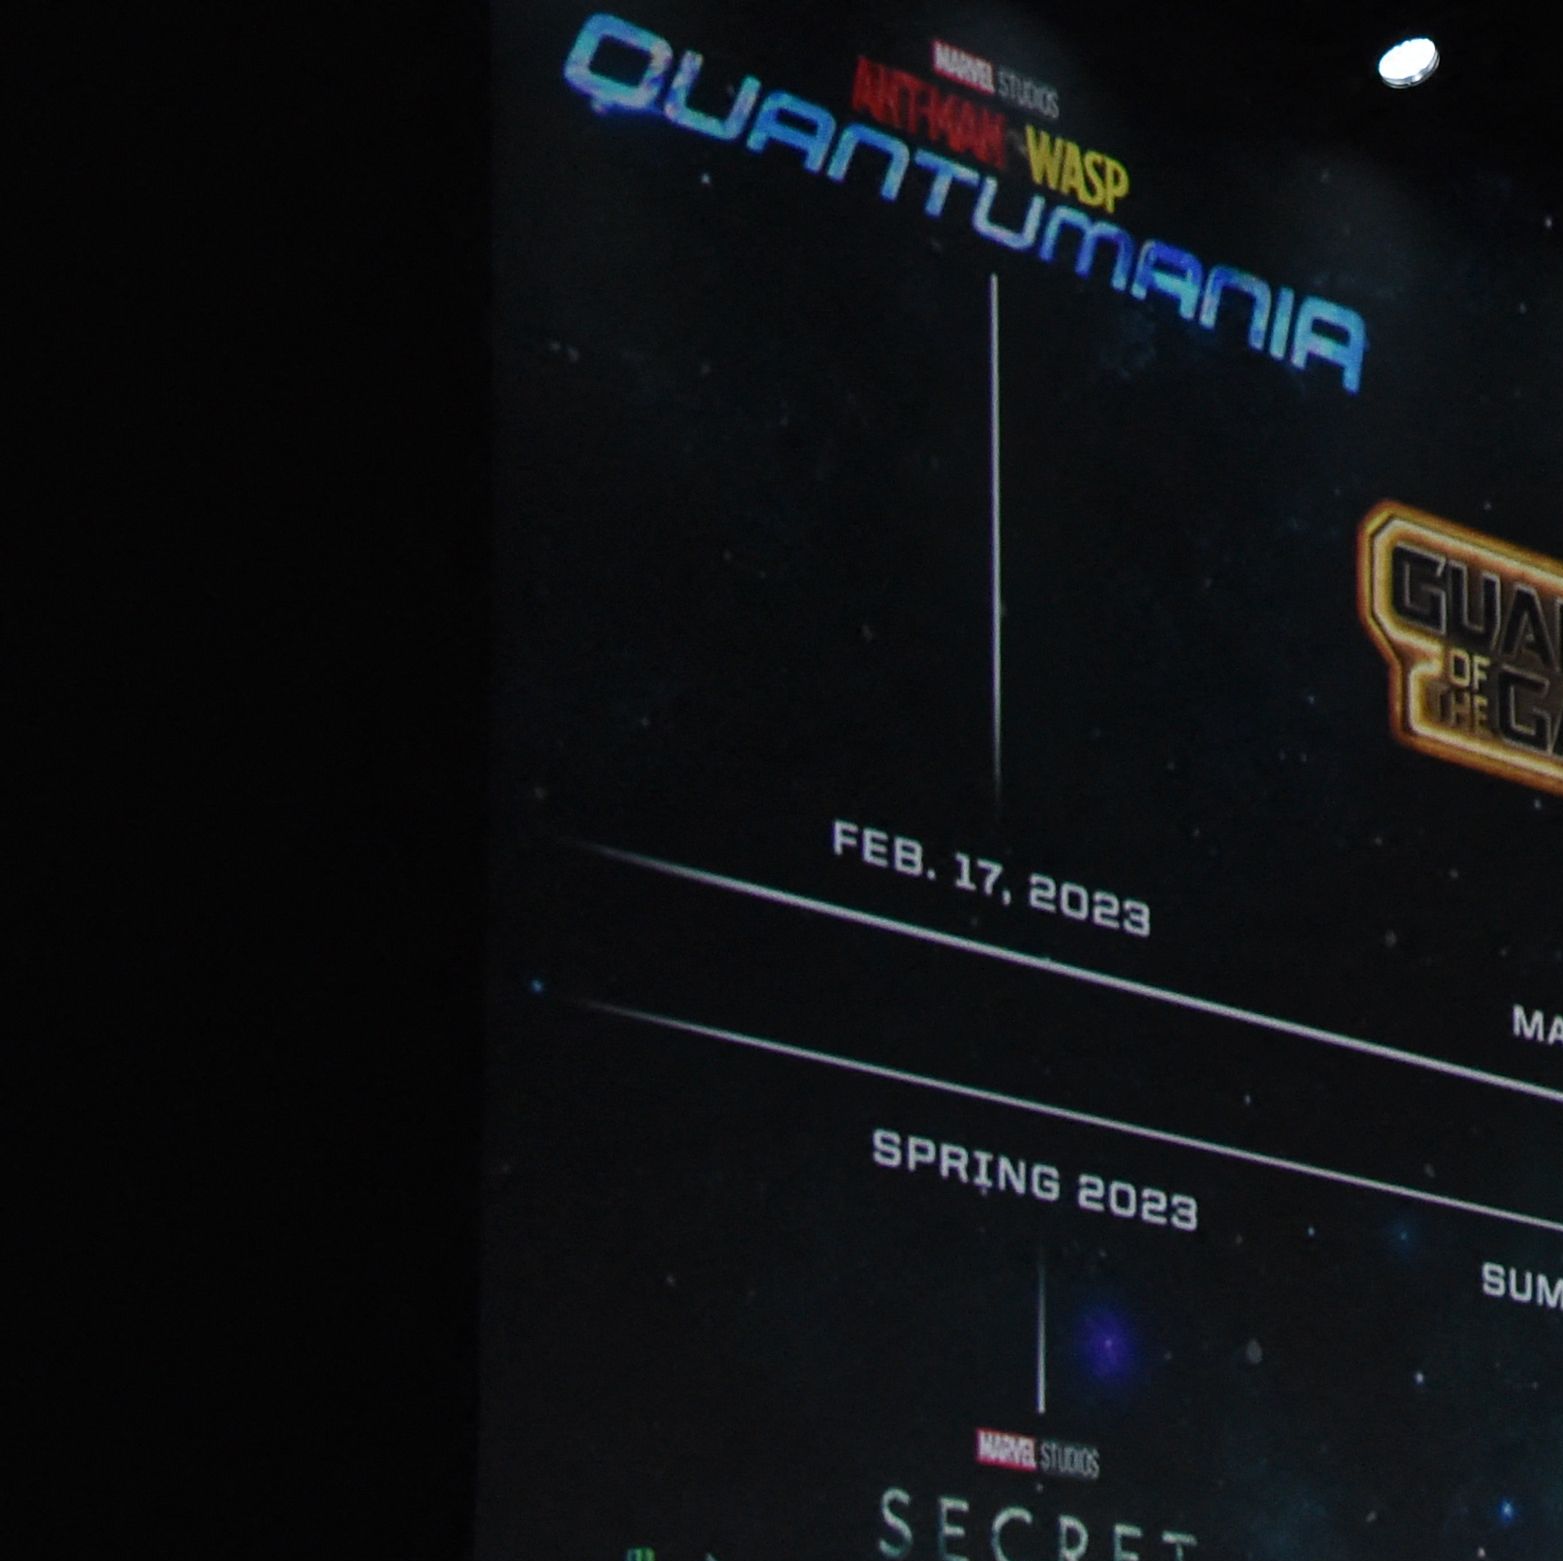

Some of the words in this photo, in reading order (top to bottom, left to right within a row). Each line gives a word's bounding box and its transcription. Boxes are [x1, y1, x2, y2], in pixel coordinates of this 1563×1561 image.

[564, 12, 1369, 394] QUANTUMANIA
[1026, 124, 1129, 213] WASP
[1436, 681, 1488, 729] THE
[1447, 649, 1491, 691] OF
[832, 819, 937, 881] FEB.
[953, 851, 1012, 907] 17,
[1028, 872, 1152, 938] 2023
[871, 1127, 1061, 1202] SPRING
[1076, 1173, 1199, 1232] 2023
[976, 1429, 1037, 1471] MARVEL
[1039, 1441, 1100, 1480] STUDIOS
